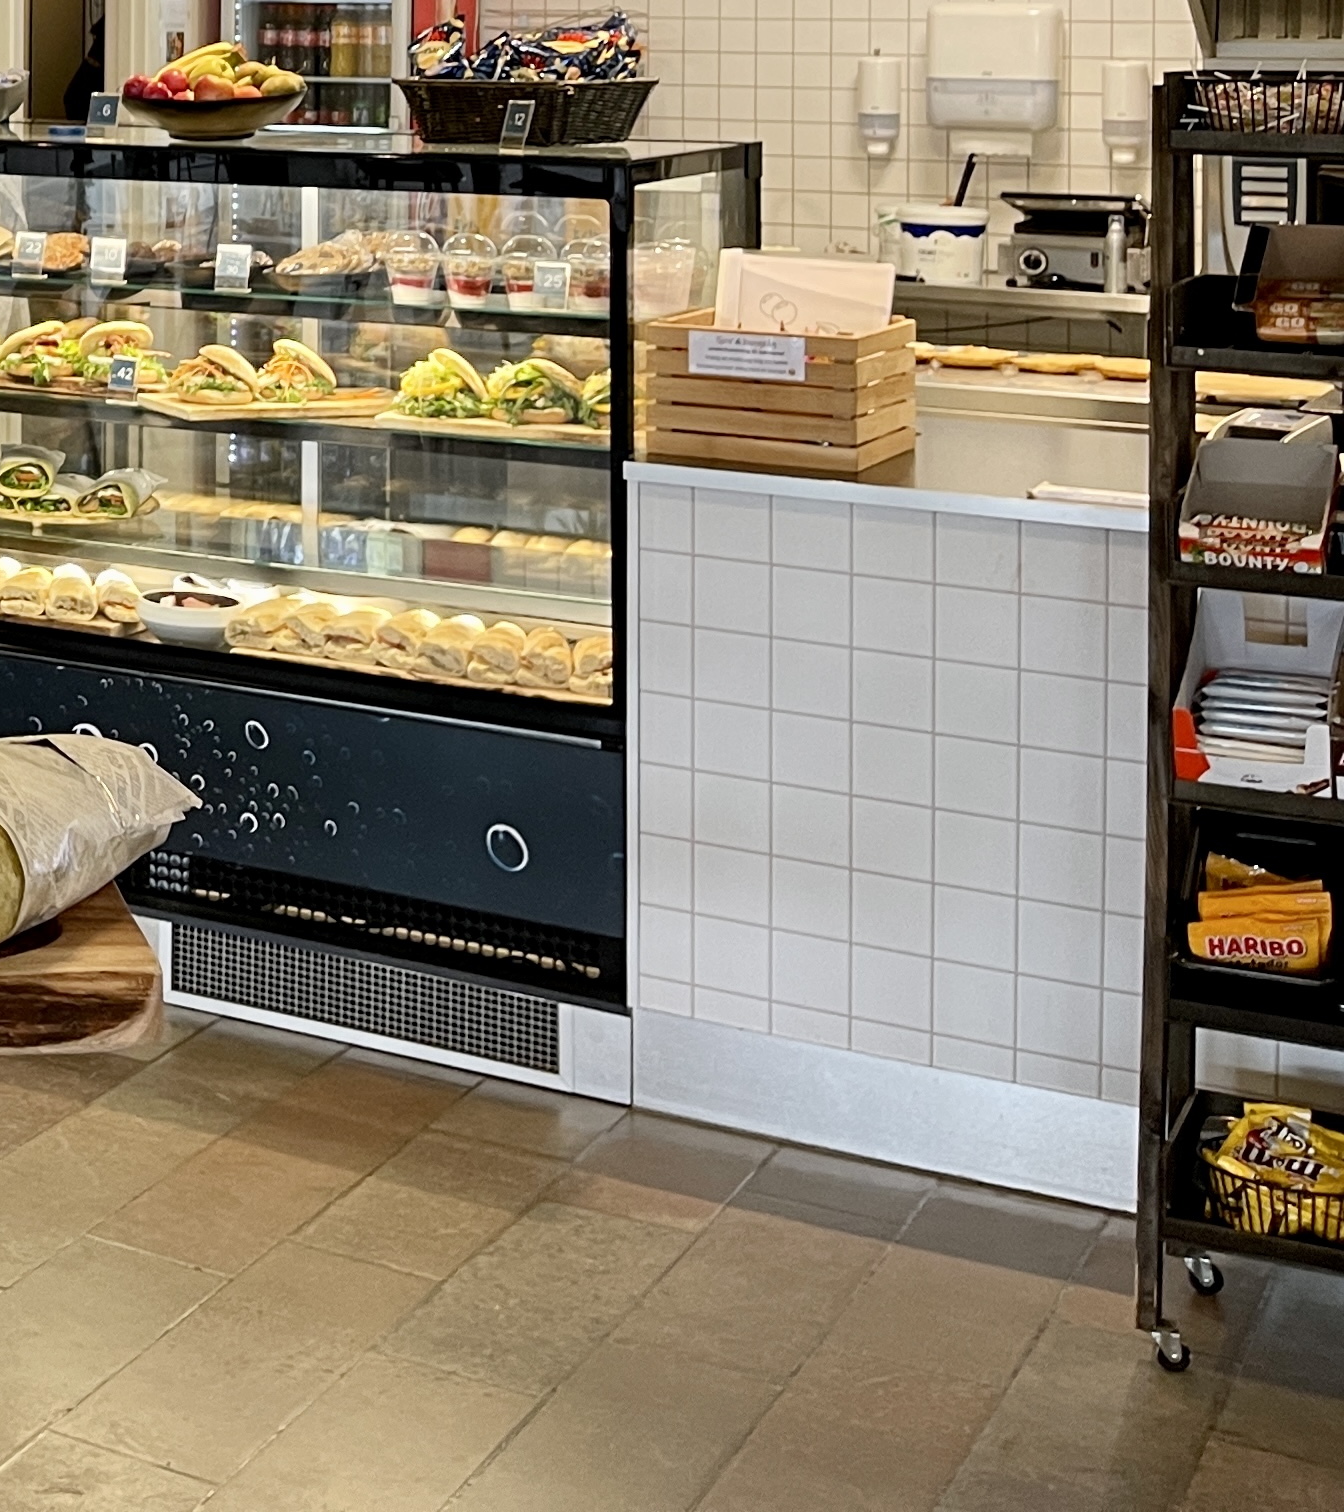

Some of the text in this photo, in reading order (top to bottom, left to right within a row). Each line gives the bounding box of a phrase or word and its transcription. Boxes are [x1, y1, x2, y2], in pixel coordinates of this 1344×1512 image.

[102, 103, 111, 117] 6
[25, 241, 42, 254] 22
[543, 273, 563, 289] 25
[116, 366, 134, 380] 42
[1204, 551, 1289, 571] BOUNTY
[1207, 936, 1306, 957] HARIBO
